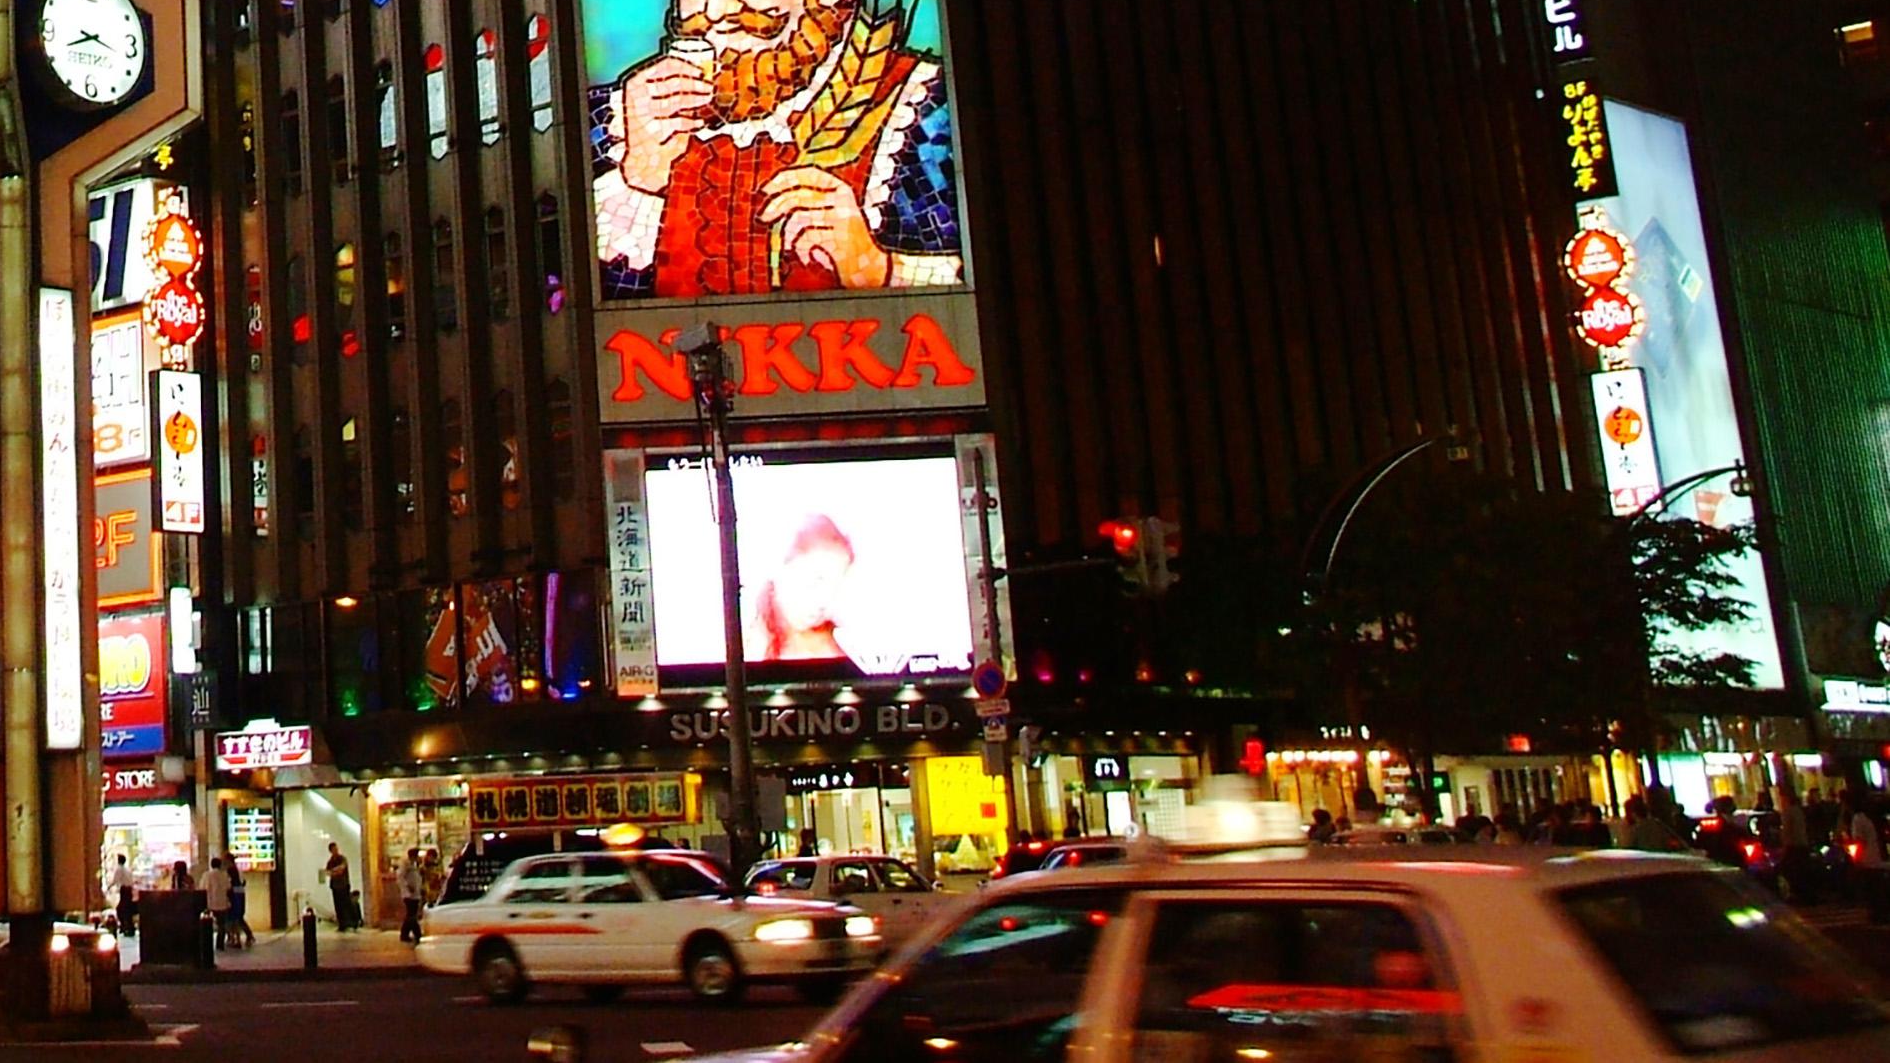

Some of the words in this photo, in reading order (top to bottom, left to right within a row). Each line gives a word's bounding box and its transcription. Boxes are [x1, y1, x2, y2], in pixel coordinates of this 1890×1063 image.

[125, 35, 138, 58] 3
[84, 74, 98, 98] 6
[1563, 81, 1586, 98] 8F
[616, 505, 647, 624] 北海道新聞
[877, 704, 959, 733] BLD.
[115, 770, 155, 789] STORE
